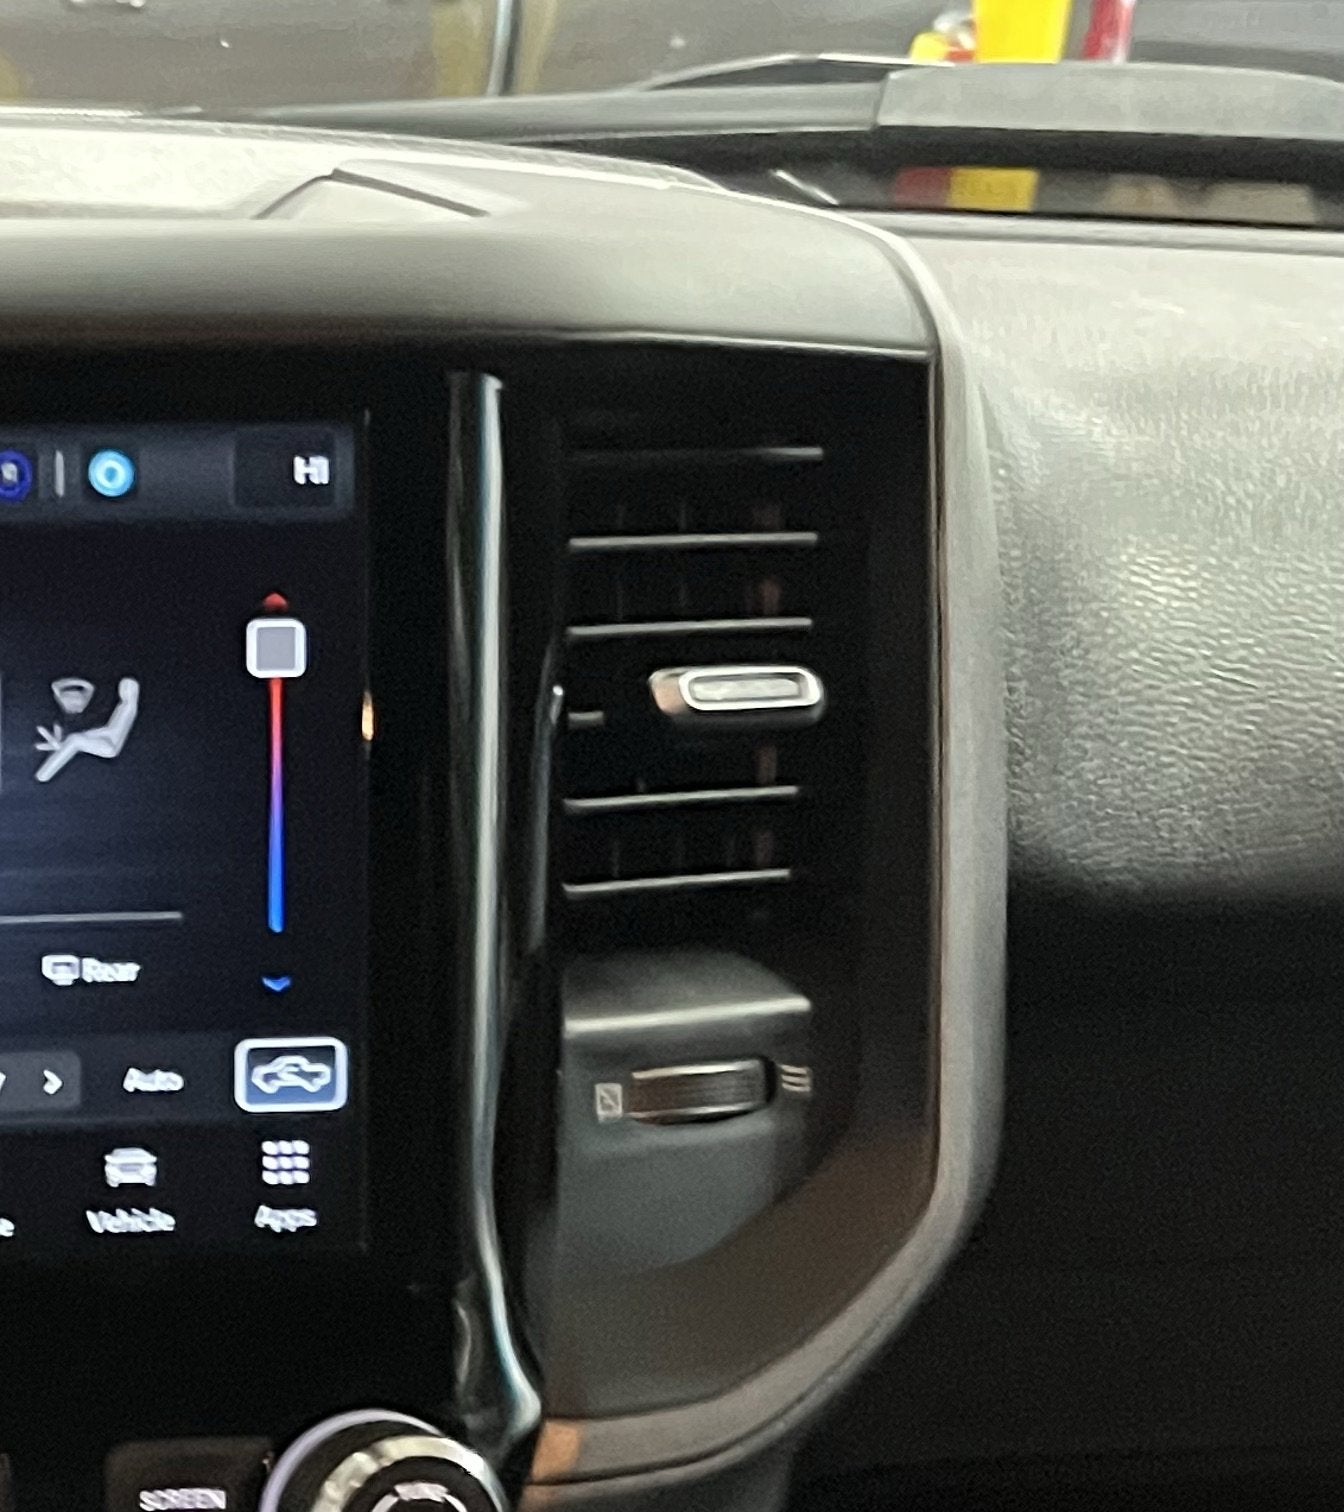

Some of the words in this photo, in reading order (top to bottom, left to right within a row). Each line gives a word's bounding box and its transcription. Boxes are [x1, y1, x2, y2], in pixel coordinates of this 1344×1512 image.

[293, 455, 329, 485] HI
[80, 957, 141, 984] Rear
[85, 1207, 176, 1234] Vehicle
[254, 1204, 317, 1233] Apps
[139, 1487, 226, 1512] SCREEN
